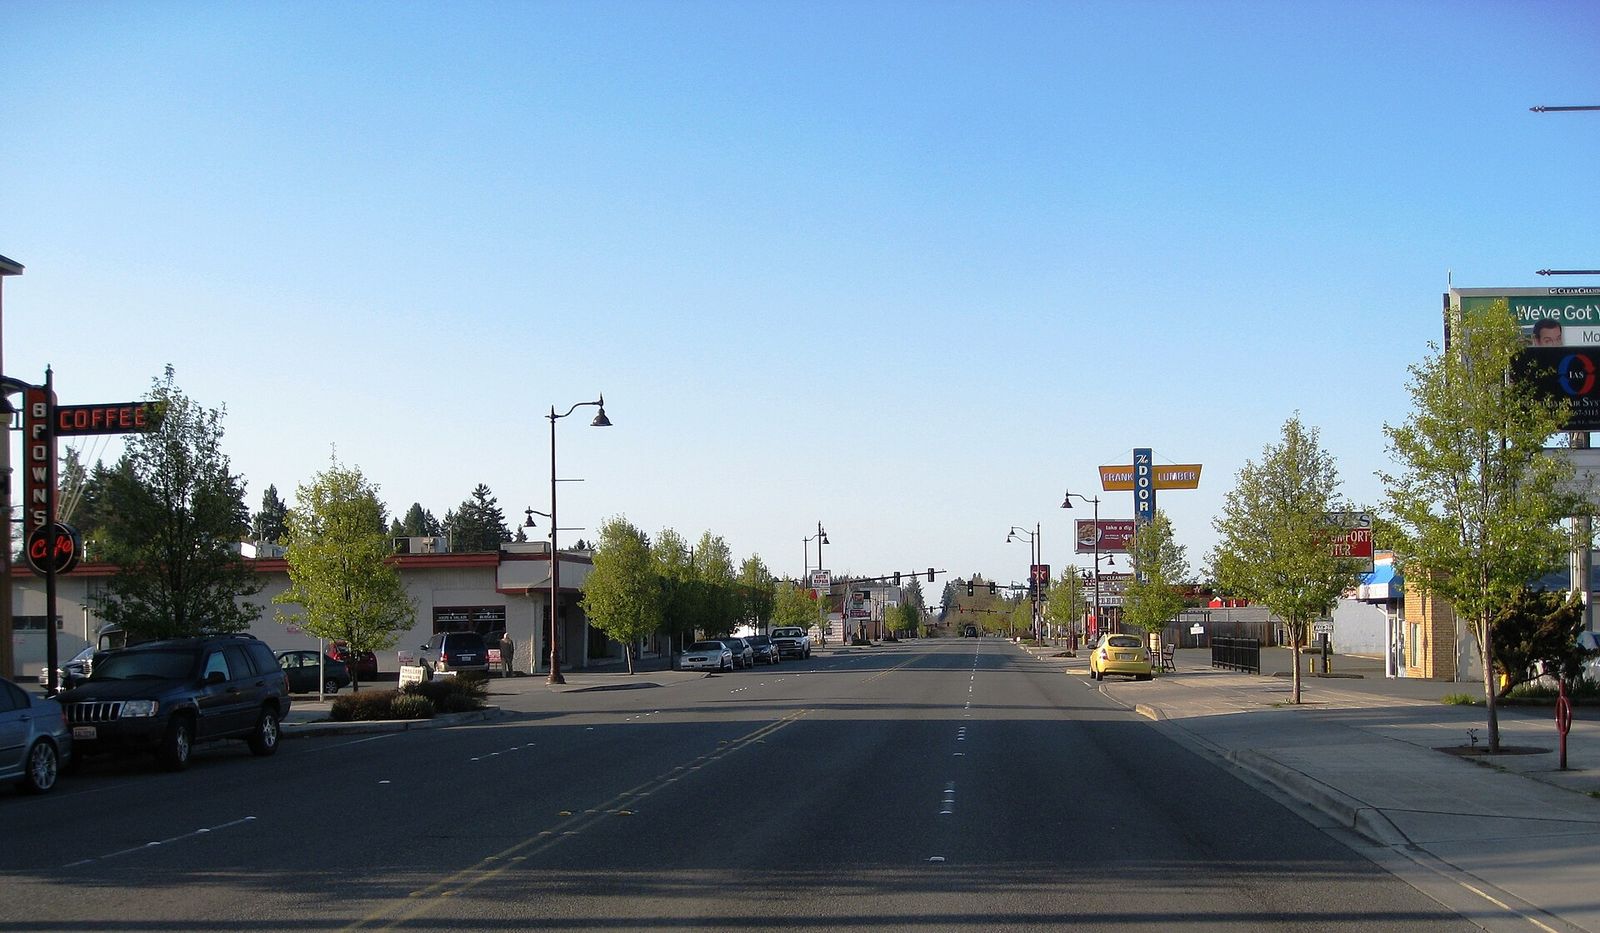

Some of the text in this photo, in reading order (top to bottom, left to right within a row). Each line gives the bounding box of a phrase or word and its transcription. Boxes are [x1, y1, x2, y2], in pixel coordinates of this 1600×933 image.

[1515, 305, 1560, 320] We've
[1564, 305, 1592, 320] Got
[1582, 331, 1600, 343] Mo
[1569, 371, 1584, 379] IAS
[60, 409, 146, 429] COFFEE
[1136, 454, 1149, 464] The
[1103, 473, 1134, 482] FRANK
[1158, 471, 1196, 481] LUMBER
[1138, 465, 1149, 512] DOOR
